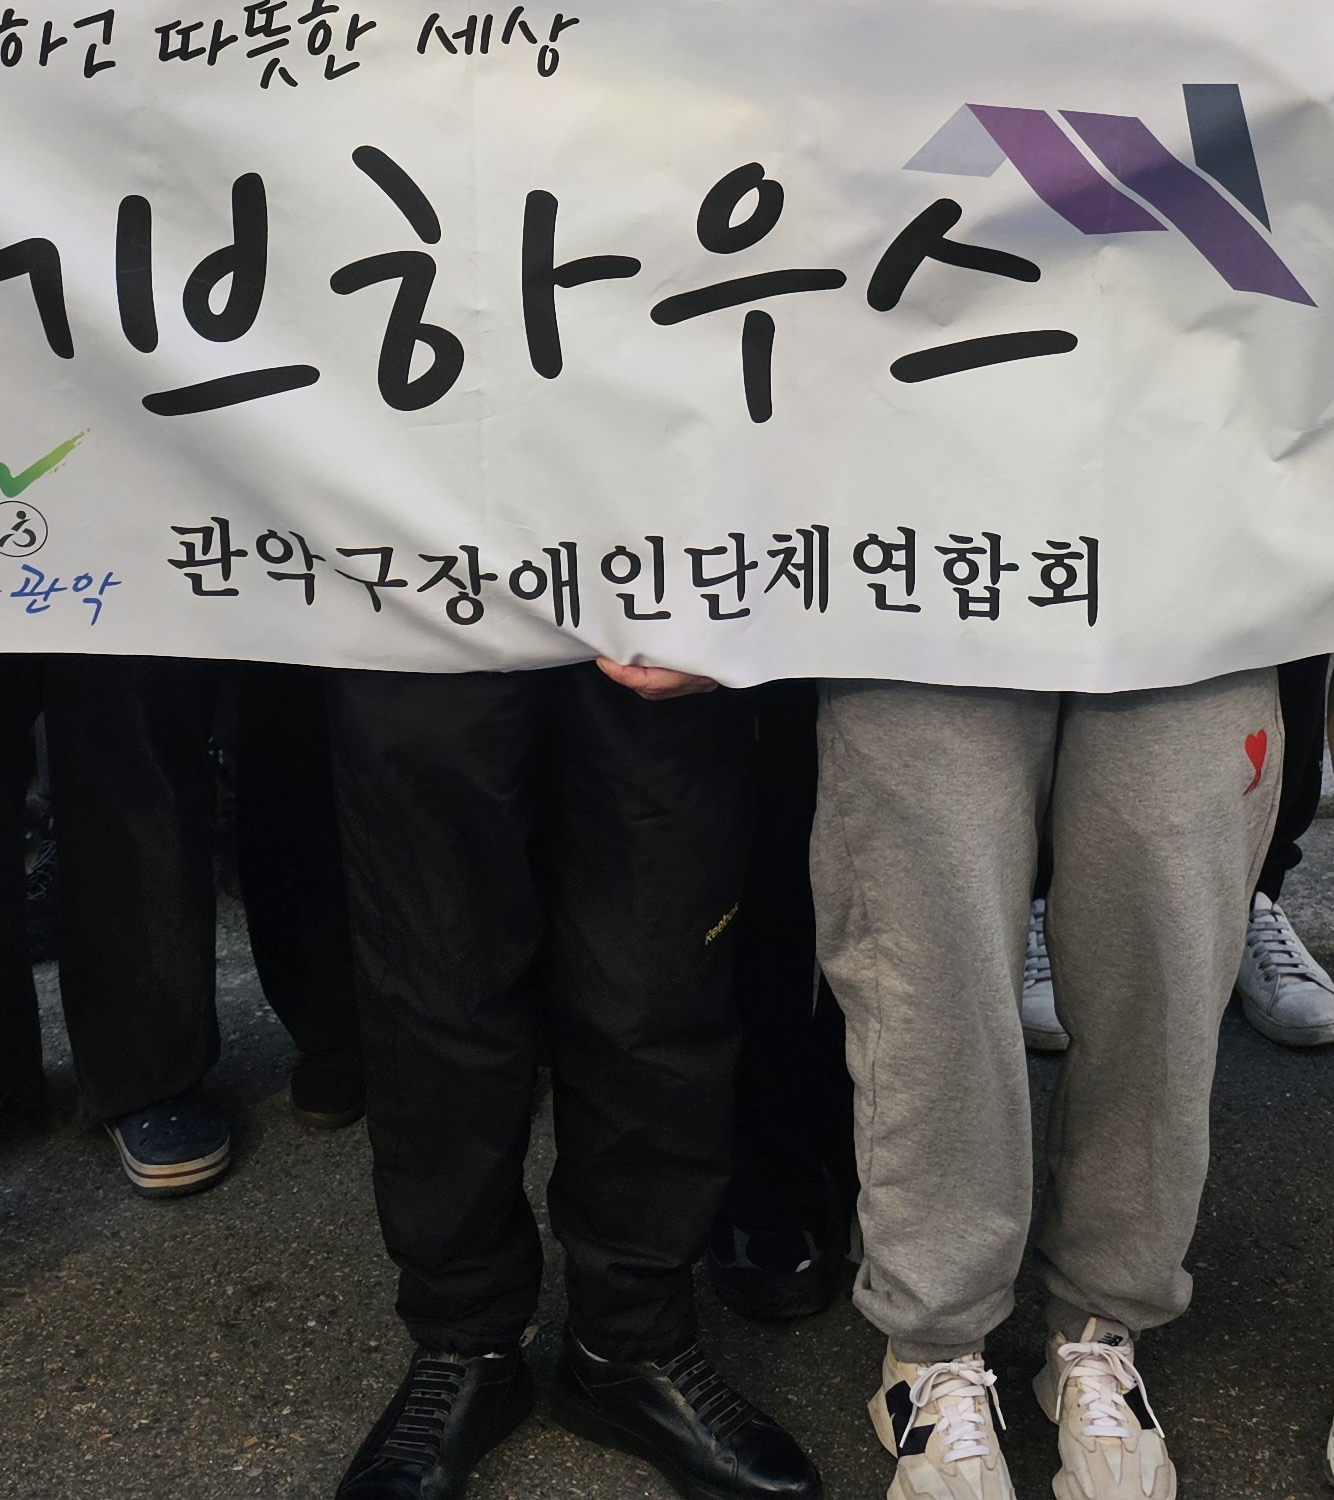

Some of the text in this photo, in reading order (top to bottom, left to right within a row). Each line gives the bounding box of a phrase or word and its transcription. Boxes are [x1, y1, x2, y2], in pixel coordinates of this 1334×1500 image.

[416, 5, 580, 78] 세상
[9, 563, 123, 627] 관악
[167, 516, 1101, 629] 관악구장애인단체연합회
